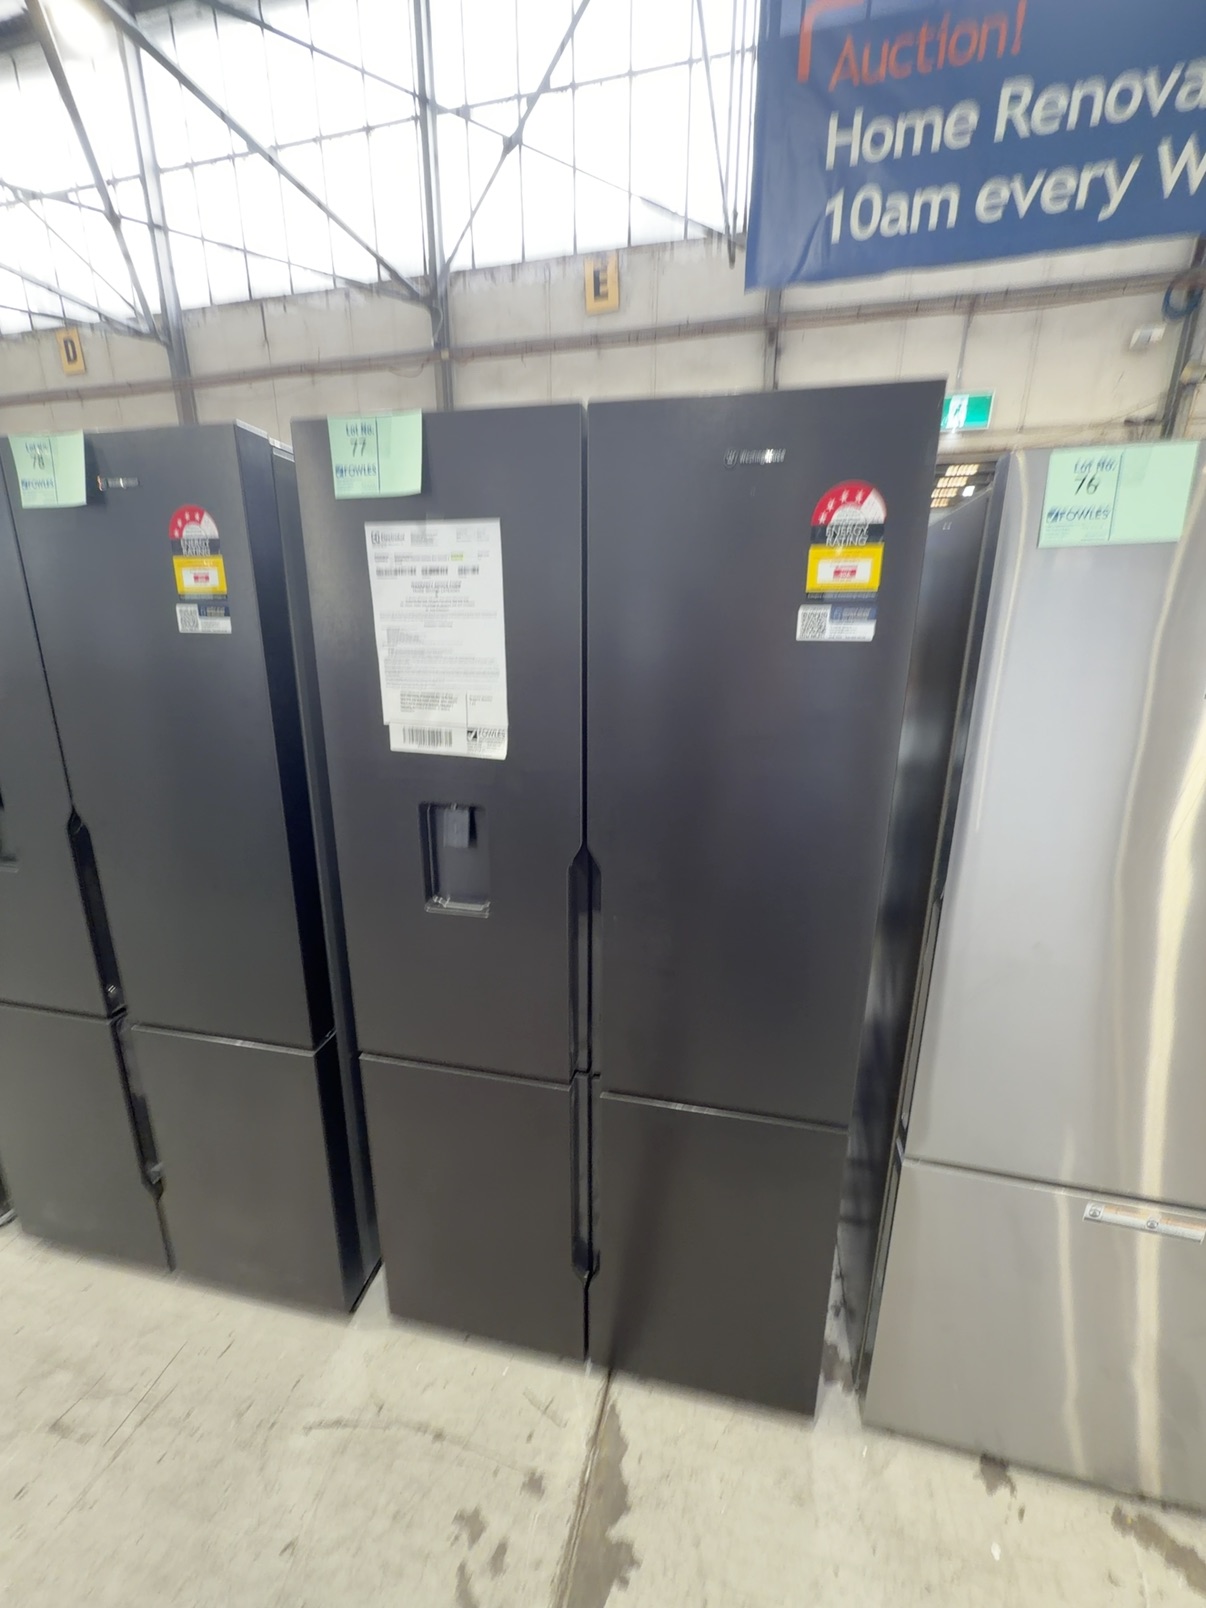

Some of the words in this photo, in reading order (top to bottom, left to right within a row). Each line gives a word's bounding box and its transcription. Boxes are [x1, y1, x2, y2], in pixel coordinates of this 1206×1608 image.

[829, 0, 1028, 92] Auction!
[825, 98, 980, 171] Home
[993, 57, 1206, 144] Renova
[825, 183, 960, 245] 10am
[975, 154, 1143, 222] every
[350, 437, 366, 457] 77
[1074, 473, 1101, 495] 76
[1058, 506, 1111, 523] FOWLES
[826, 523, 870, 537] ENERGY
[825, 534, 869, 548] RATING
